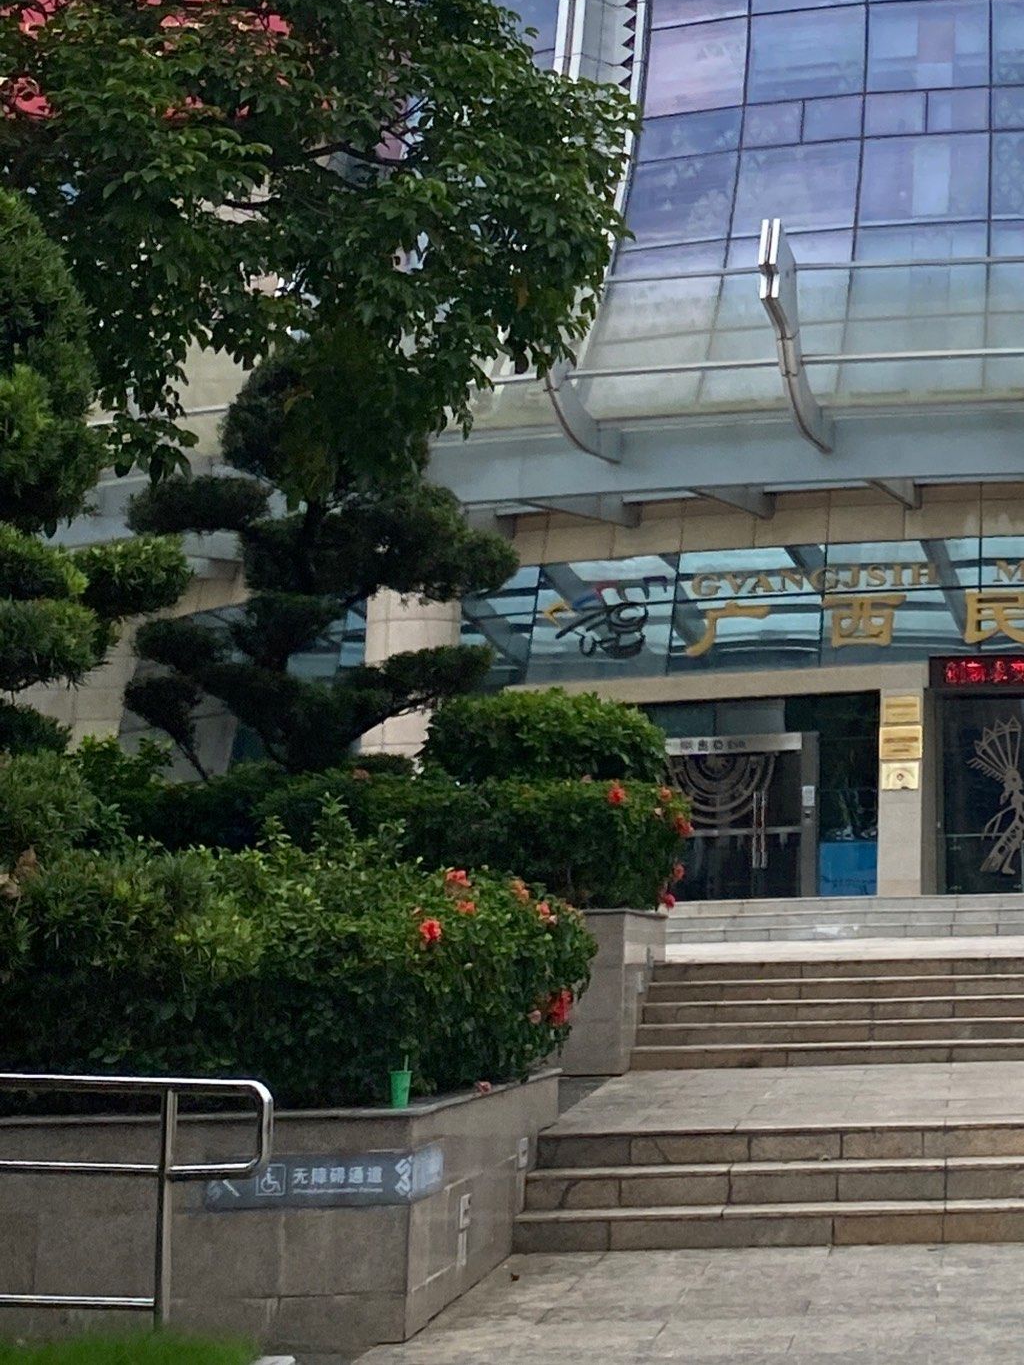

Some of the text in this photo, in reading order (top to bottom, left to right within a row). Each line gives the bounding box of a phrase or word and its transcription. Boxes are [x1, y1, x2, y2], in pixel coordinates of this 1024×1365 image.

[691, 562, 939, 596] GVANGJSIH
[292, 1166, 383, 1184] 无障碍通道
